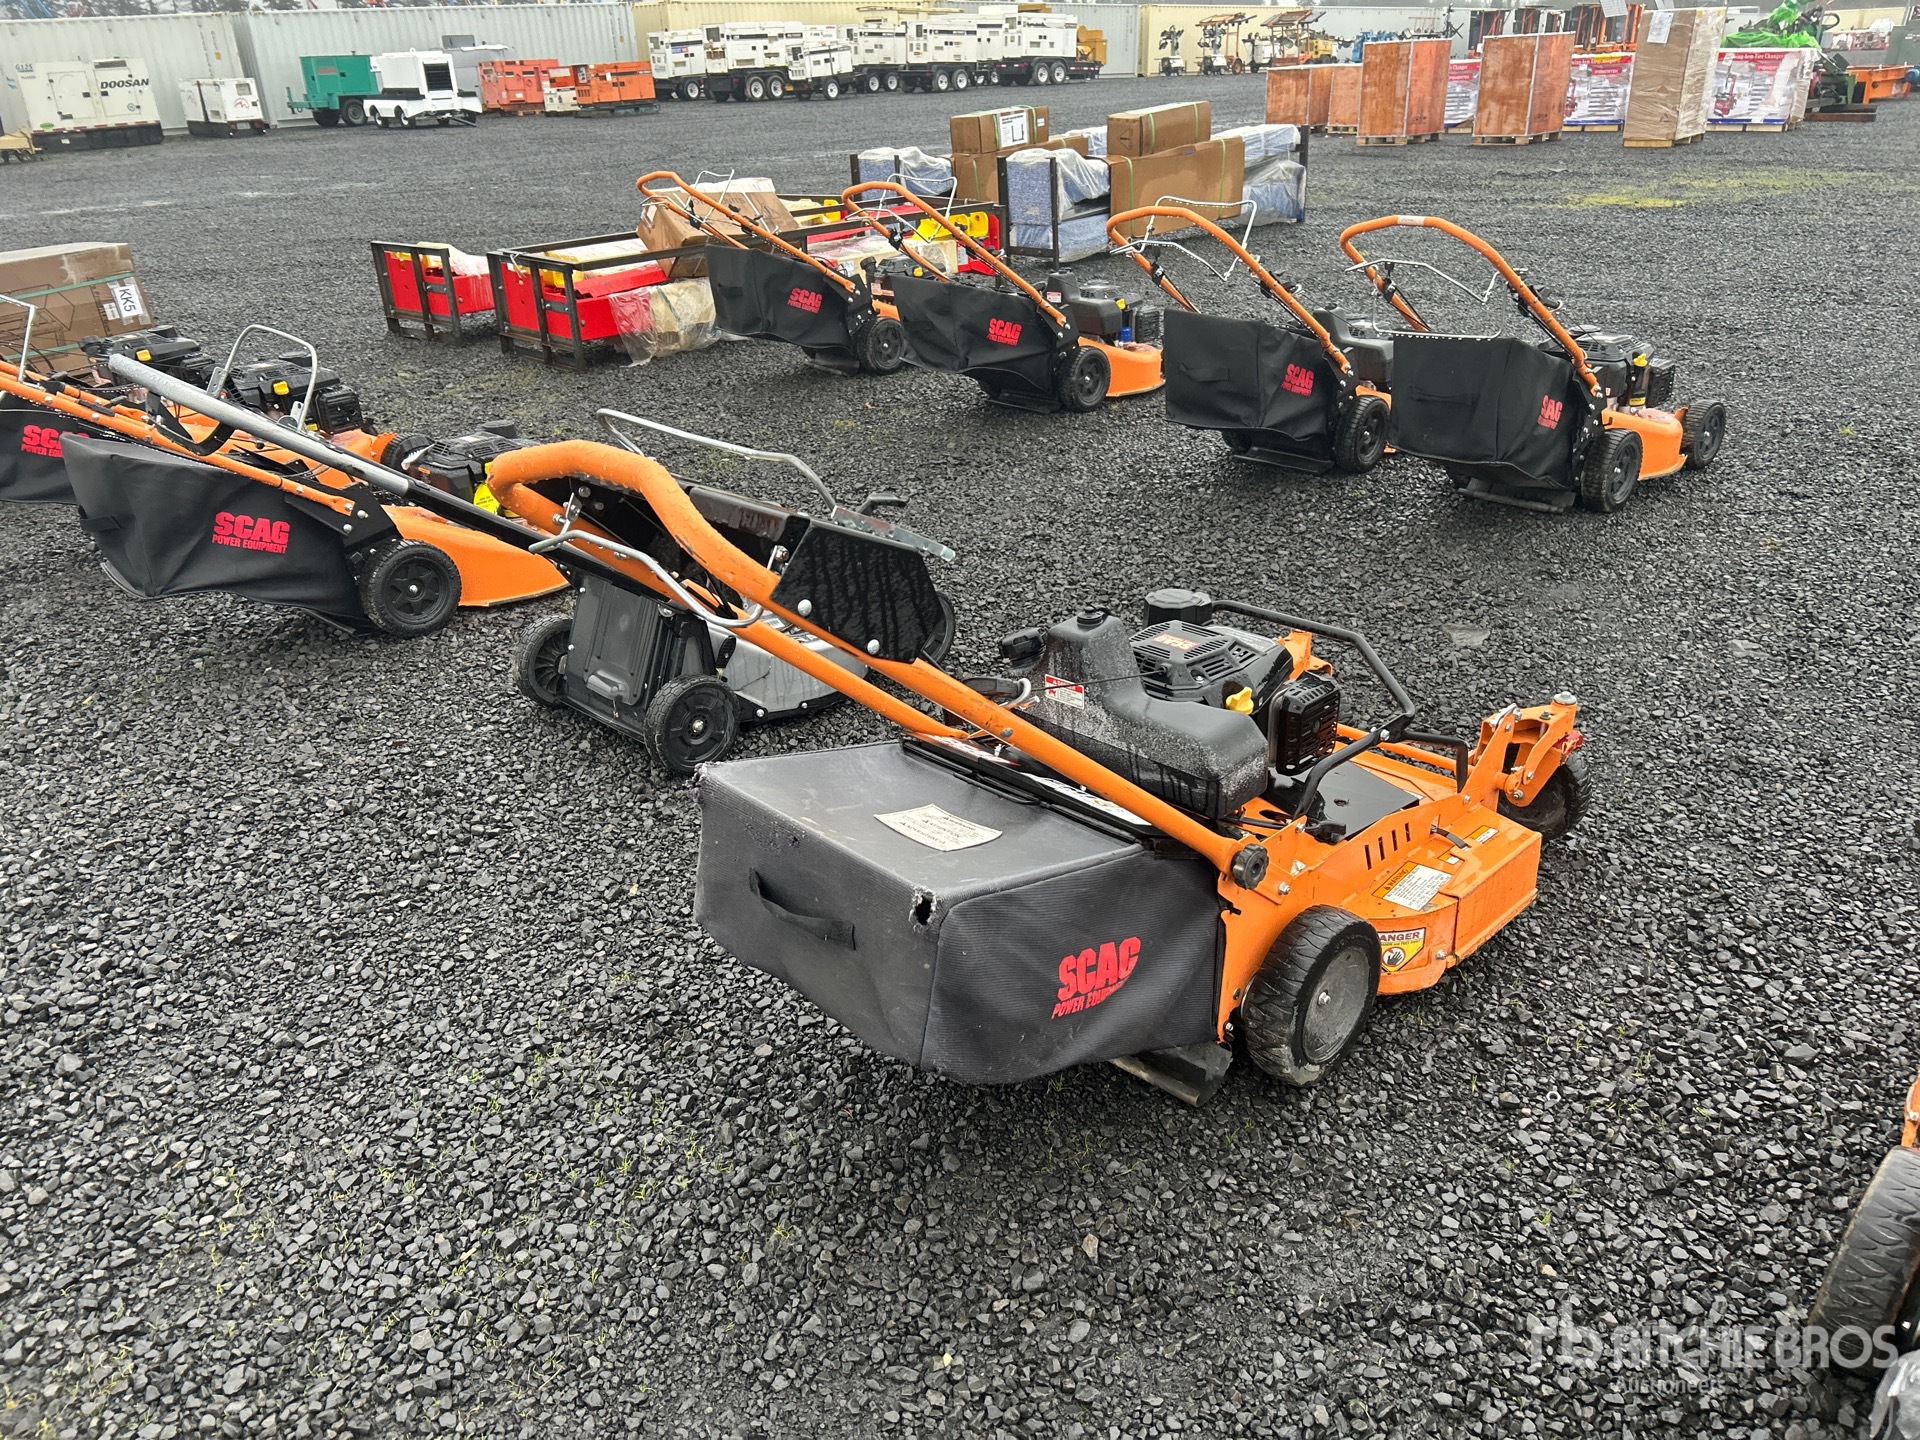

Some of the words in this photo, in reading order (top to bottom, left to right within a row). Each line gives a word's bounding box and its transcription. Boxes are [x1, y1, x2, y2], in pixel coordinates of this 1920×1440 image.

[100, 78, 149, 89] DOOSAN
[118, 288, 136, 312] KK5
[789, 287, 823, 308] SCAG
[988, 318, 1023, 340] SCAG
[1284, 363, 1315, 390] SCAG
[21, 444, 48, 456] POWER
[213, 511, 291, 545] SCAG
[212, 534, 242, 548] POWER
[242, 538, 288, 554] EQUIPMENT
[1380, 932, 1420, 942] ANGER
[1057, 936, 1142, 1002] SCAG
[1051, 995, 1086, 1020] POWER
